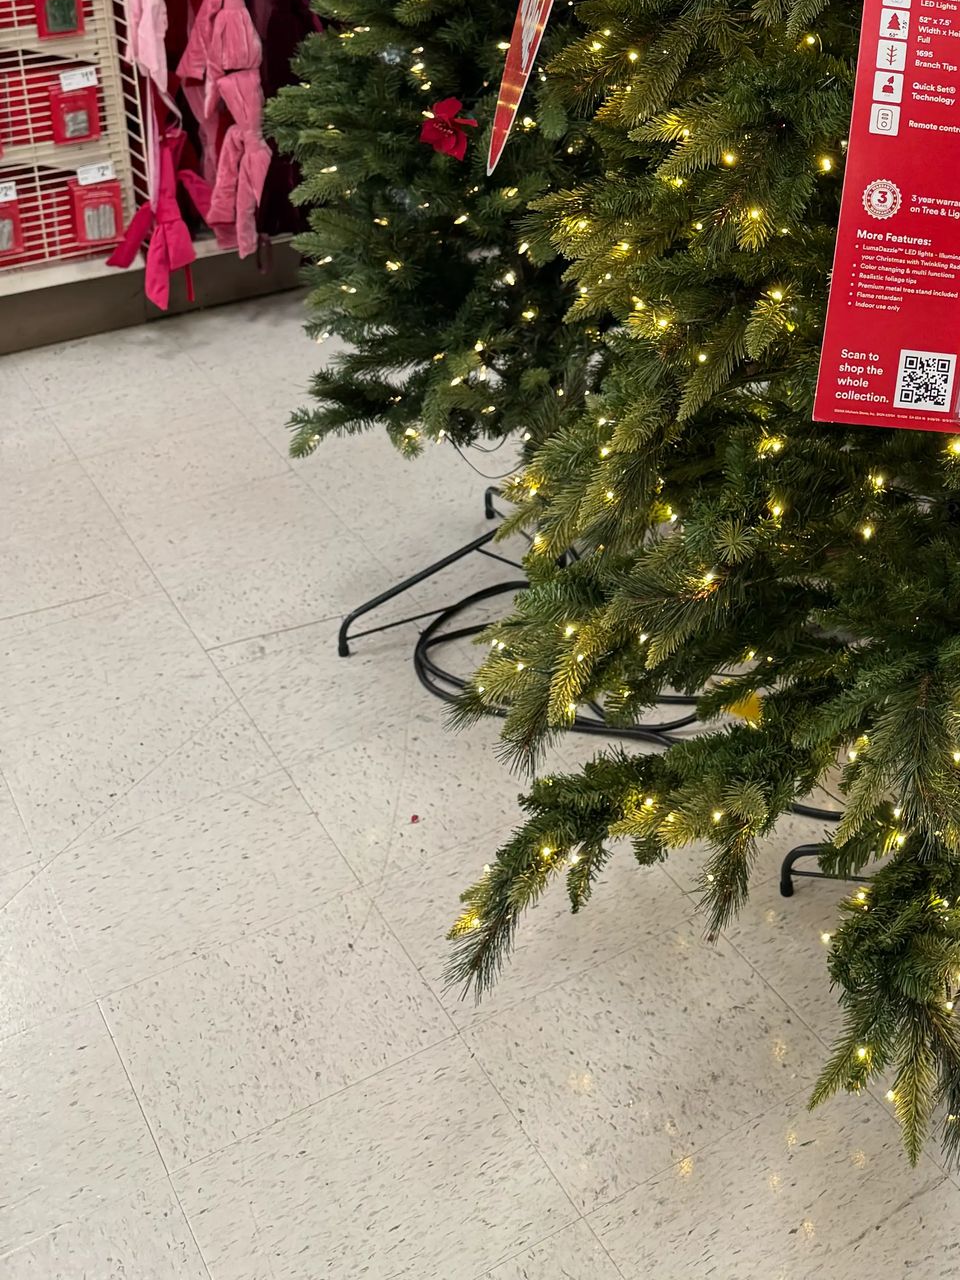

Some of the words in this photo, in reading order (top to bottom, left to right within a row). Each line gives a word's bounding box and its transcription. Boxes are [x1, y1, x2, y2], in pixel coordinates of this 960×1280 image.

[920, 0, 935, 8] LED
[935, 1, 958, 11] Lights
[918, 25, 941, 35] Width
[917, 35, 931, 44] Full
[914, 59, 941, 69] Branch
[941, 62, 958, 72] Tips
[911, 91, 956, 106] Technology
[908, 119, 938, 131] Remote
[876, 190, 888, 204] 3
[910, 194, 917, 202] 3
[917, 196, 936, 205] year
[921, 205, 939, 216] Tree
[939, 208, 947, 216] &
[856, 229, 884, 241] More
[885, 232, 932, 246] Features:
[875, 254, 906, 264] Christmas
[906, 258, 920, 266] with
[920, 259, 949, 270] Twinkling
[859, 262, 878, 270] Color
[877, 265, 906, 275] changing
[911, 268, 927, 276] multi
[927, 270, 955, 279] functions
[857, 281, 885, 290] Premium
[855, 300, 876, 309] Indoor
[886, 304, 901, 313] only
[840, 348, 866, 360] Scan
[868, 352, 880, 362] to
[839, 362, 864, 375] shop
[866, 365, 884, 376] the
[837, 376, 869, 388] whole
[835, 390, 889, 403] collection.
